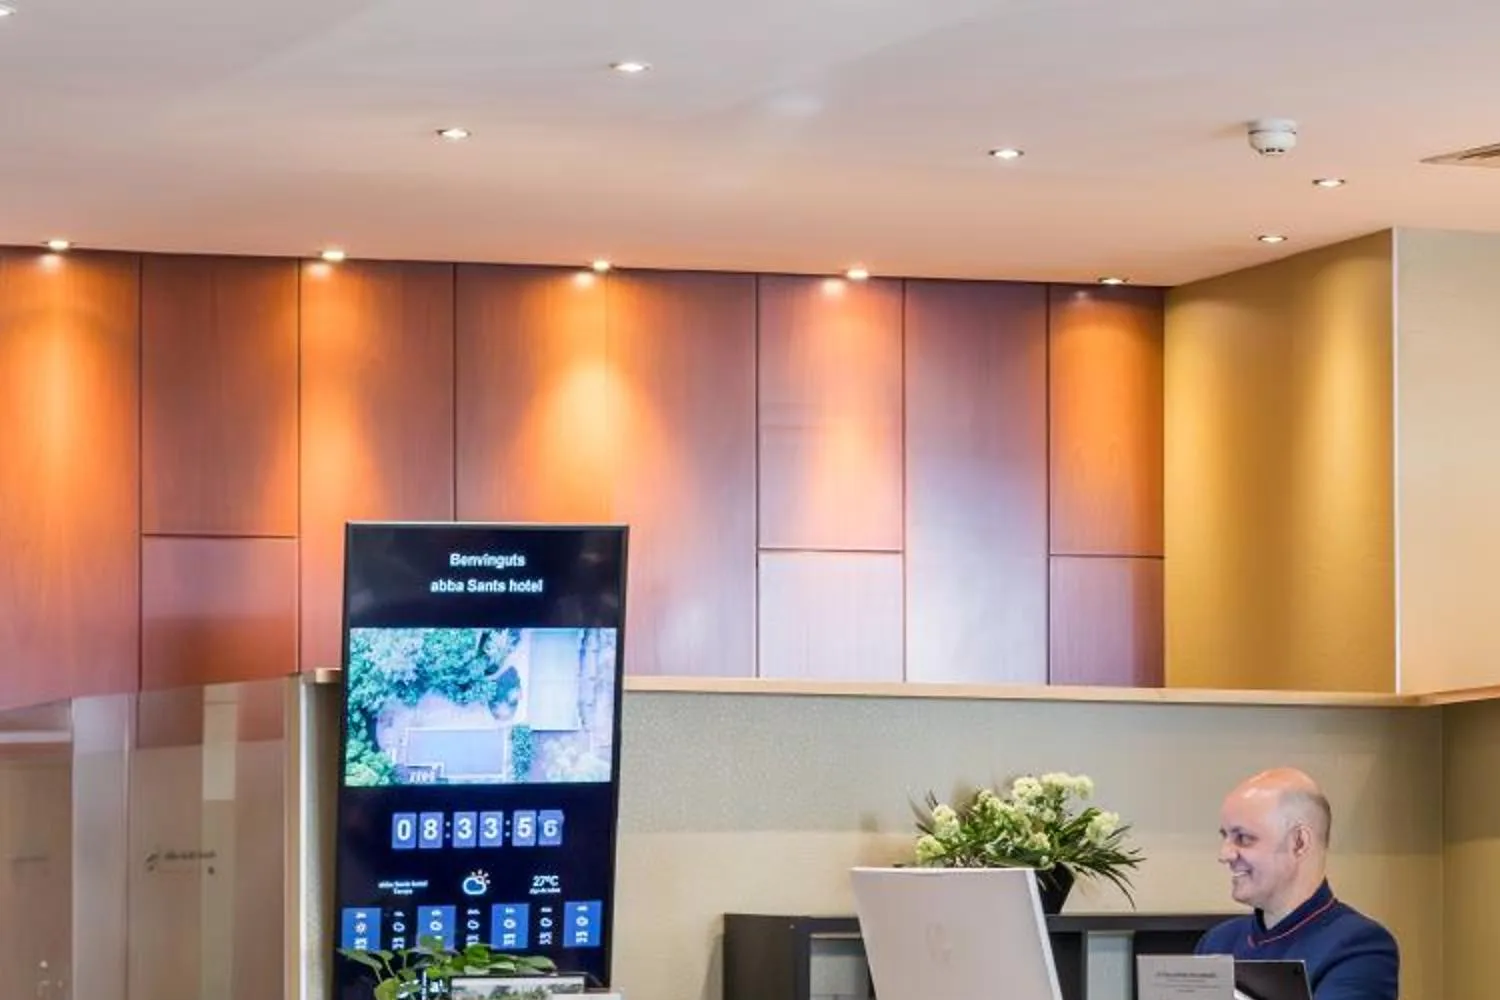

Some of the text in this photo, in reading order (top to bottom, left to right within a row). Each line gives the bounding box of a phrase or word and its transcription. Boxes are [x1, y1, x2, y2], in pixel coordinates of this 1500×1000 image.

[449, 553, 526, 569] Benvinguts
[430, 578, 543, 592] abba Sants hotel
[397, 816, 558, 841] 08:33:56
